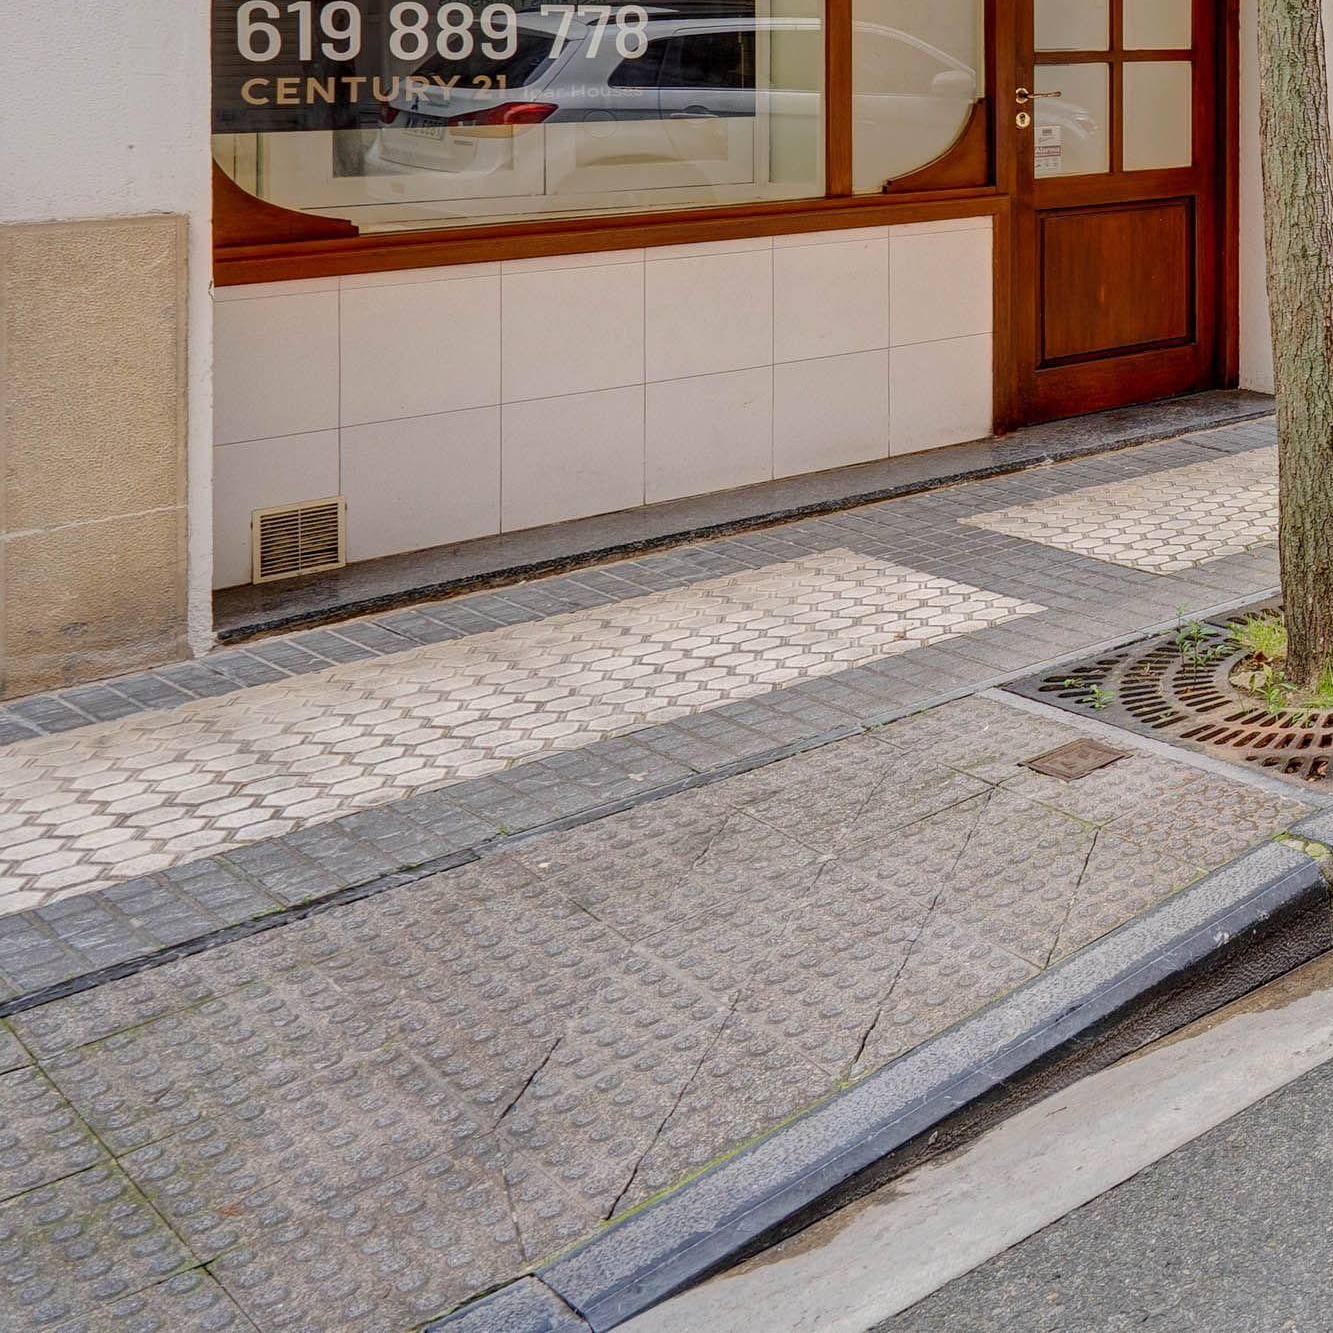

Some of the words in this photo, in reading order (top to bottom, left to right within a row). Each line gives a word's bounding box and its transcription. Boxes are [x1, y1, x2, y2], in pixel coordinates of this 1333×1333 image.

[236, 0, 362, 63] 619
[389, 1, 517, 61] 889
[540, 4, 649, 60] 778
[241, 75, 461, 106] CENTURY
[472, 74, 507, 101] 21
